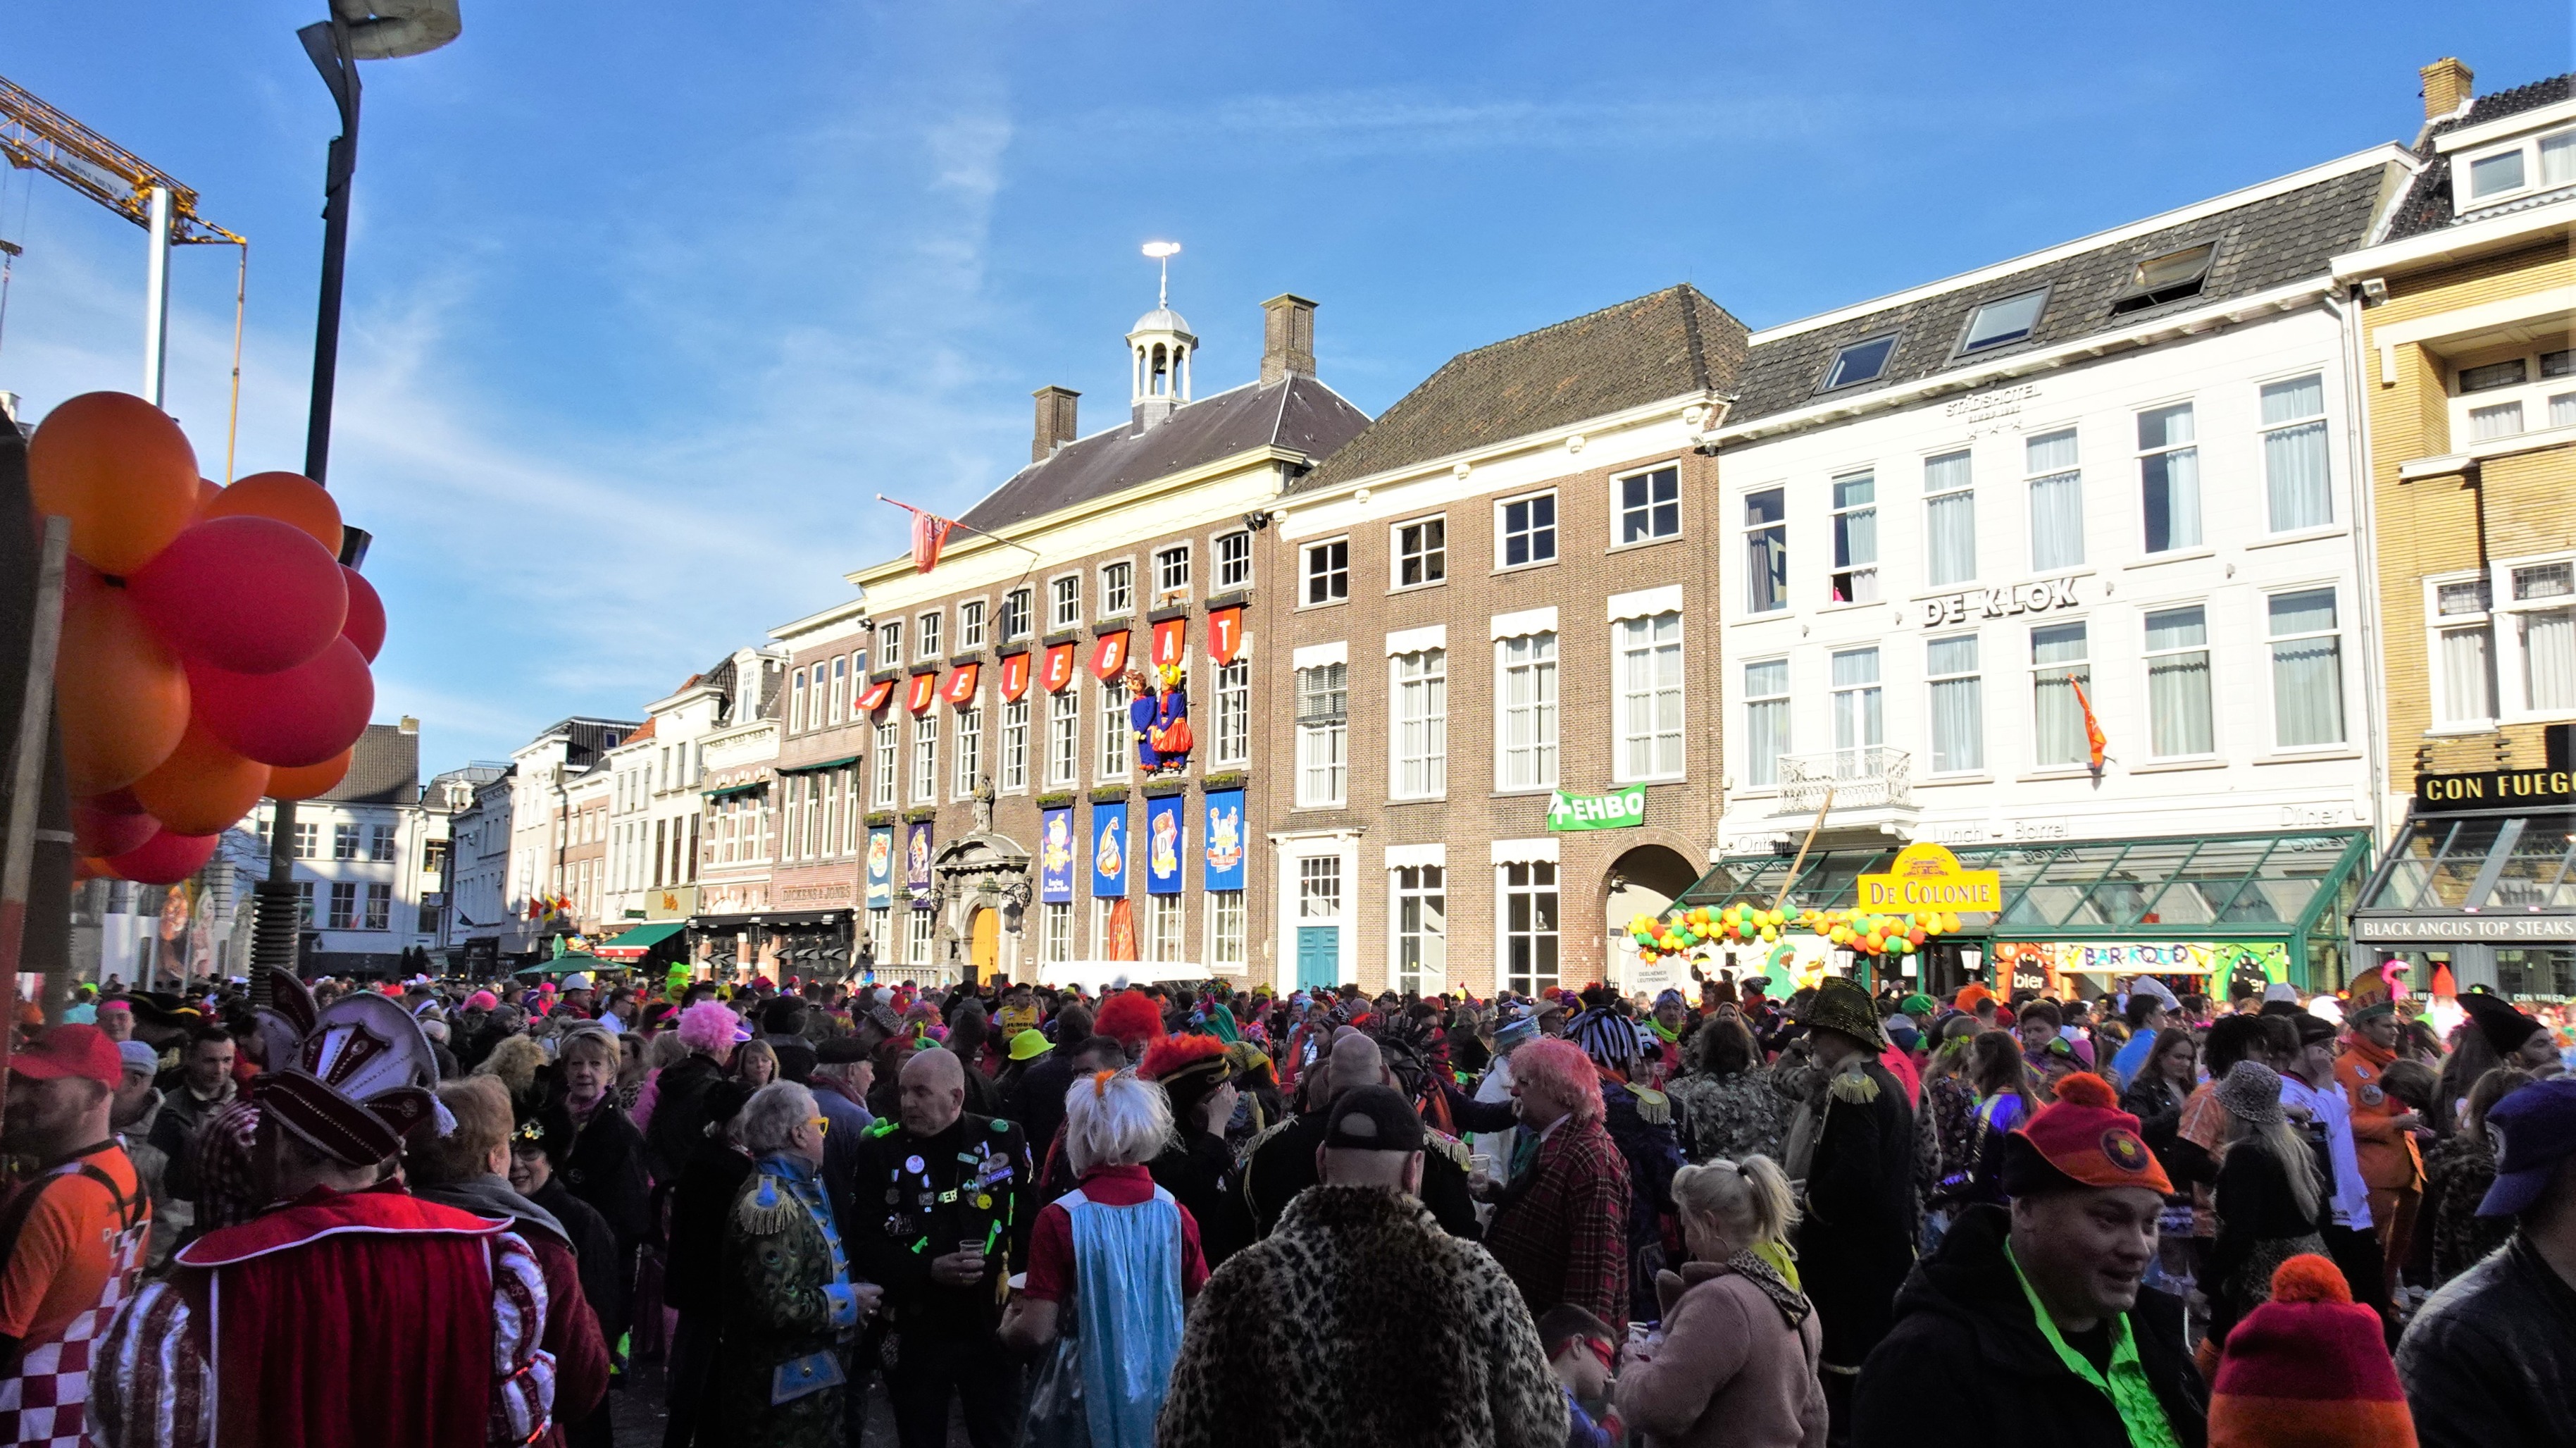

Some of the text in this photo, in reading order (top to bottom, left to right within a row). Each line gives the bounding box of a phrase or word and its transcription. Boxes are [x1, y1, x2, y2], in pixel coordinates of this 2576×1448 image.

[1946, 384, 2042, 417] STADSHOTEL
[1921, 576, 2079, 628] DE KLOK
[2426, 772, 2576, 801] CON FUEG
[1572, 792, 1644, 821] EHBO
[1934, 821, 1984, 843] Lunch
[2015, 815, 2069, 840] Borrel
[2281, 806, 2343, 827] Diner
[783, 888, 817, 901] DICKENS
[825, 886, 851, 899] JONES
[1870, 881, 1991, 905] DE COLONIE
[2364, 920, 2575, 936] BLACK ANGUS TOP STEAKS
[2085, 947, 2122, 966] BAR
[2013, 971, 2044, 989] bier
